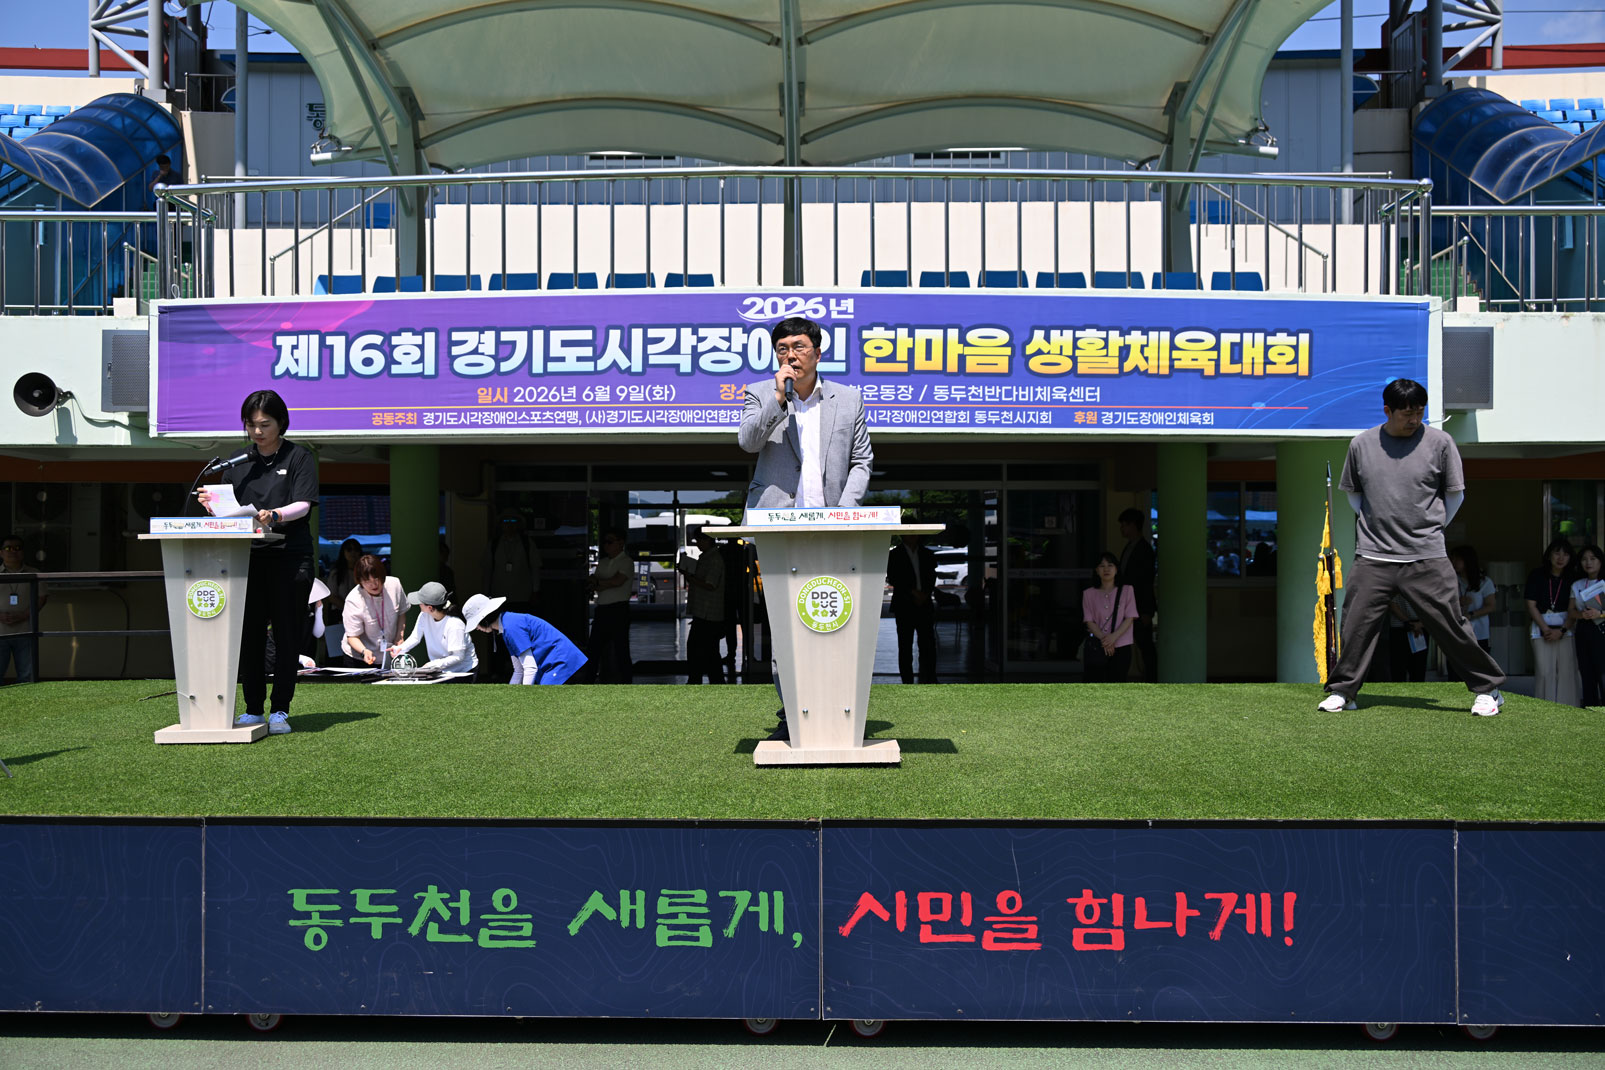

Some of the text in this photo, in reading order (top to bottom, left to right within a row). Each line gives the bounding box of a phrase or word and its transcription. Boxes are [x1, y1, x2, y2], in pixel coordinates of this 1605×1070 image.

[736, 296, 855, 322] 2026년
[274, 332, 436, 379] 제16회
[861, 326, 1012, 374] 한마음
[1025, 328, 1310, 377] 생활체육대회
[477, 386, 508, 403] 일시
[513, 385, 577, 403] 2026년
[582, 384, 611, 402] 6월
[616, 384, 676, 402] 9일(화)
[850, 384, 914, 401] 운동장
[933, 384, 1101, 403] 동두천반다비체육센터
[372, 412, 417, 426] 공동주최
[423, 410, 582, 426] 경기도시각장애인스포츠연맹,
[974, 410, 1052, 425] 동두천시지회
[1073, 411, 1098, 425] 후원
[1101, 411, 1215, 426] 경기도장애인체육회
[287, 884, 1297, 952] 동두천을 새롭게, 시민을 힘나게!
